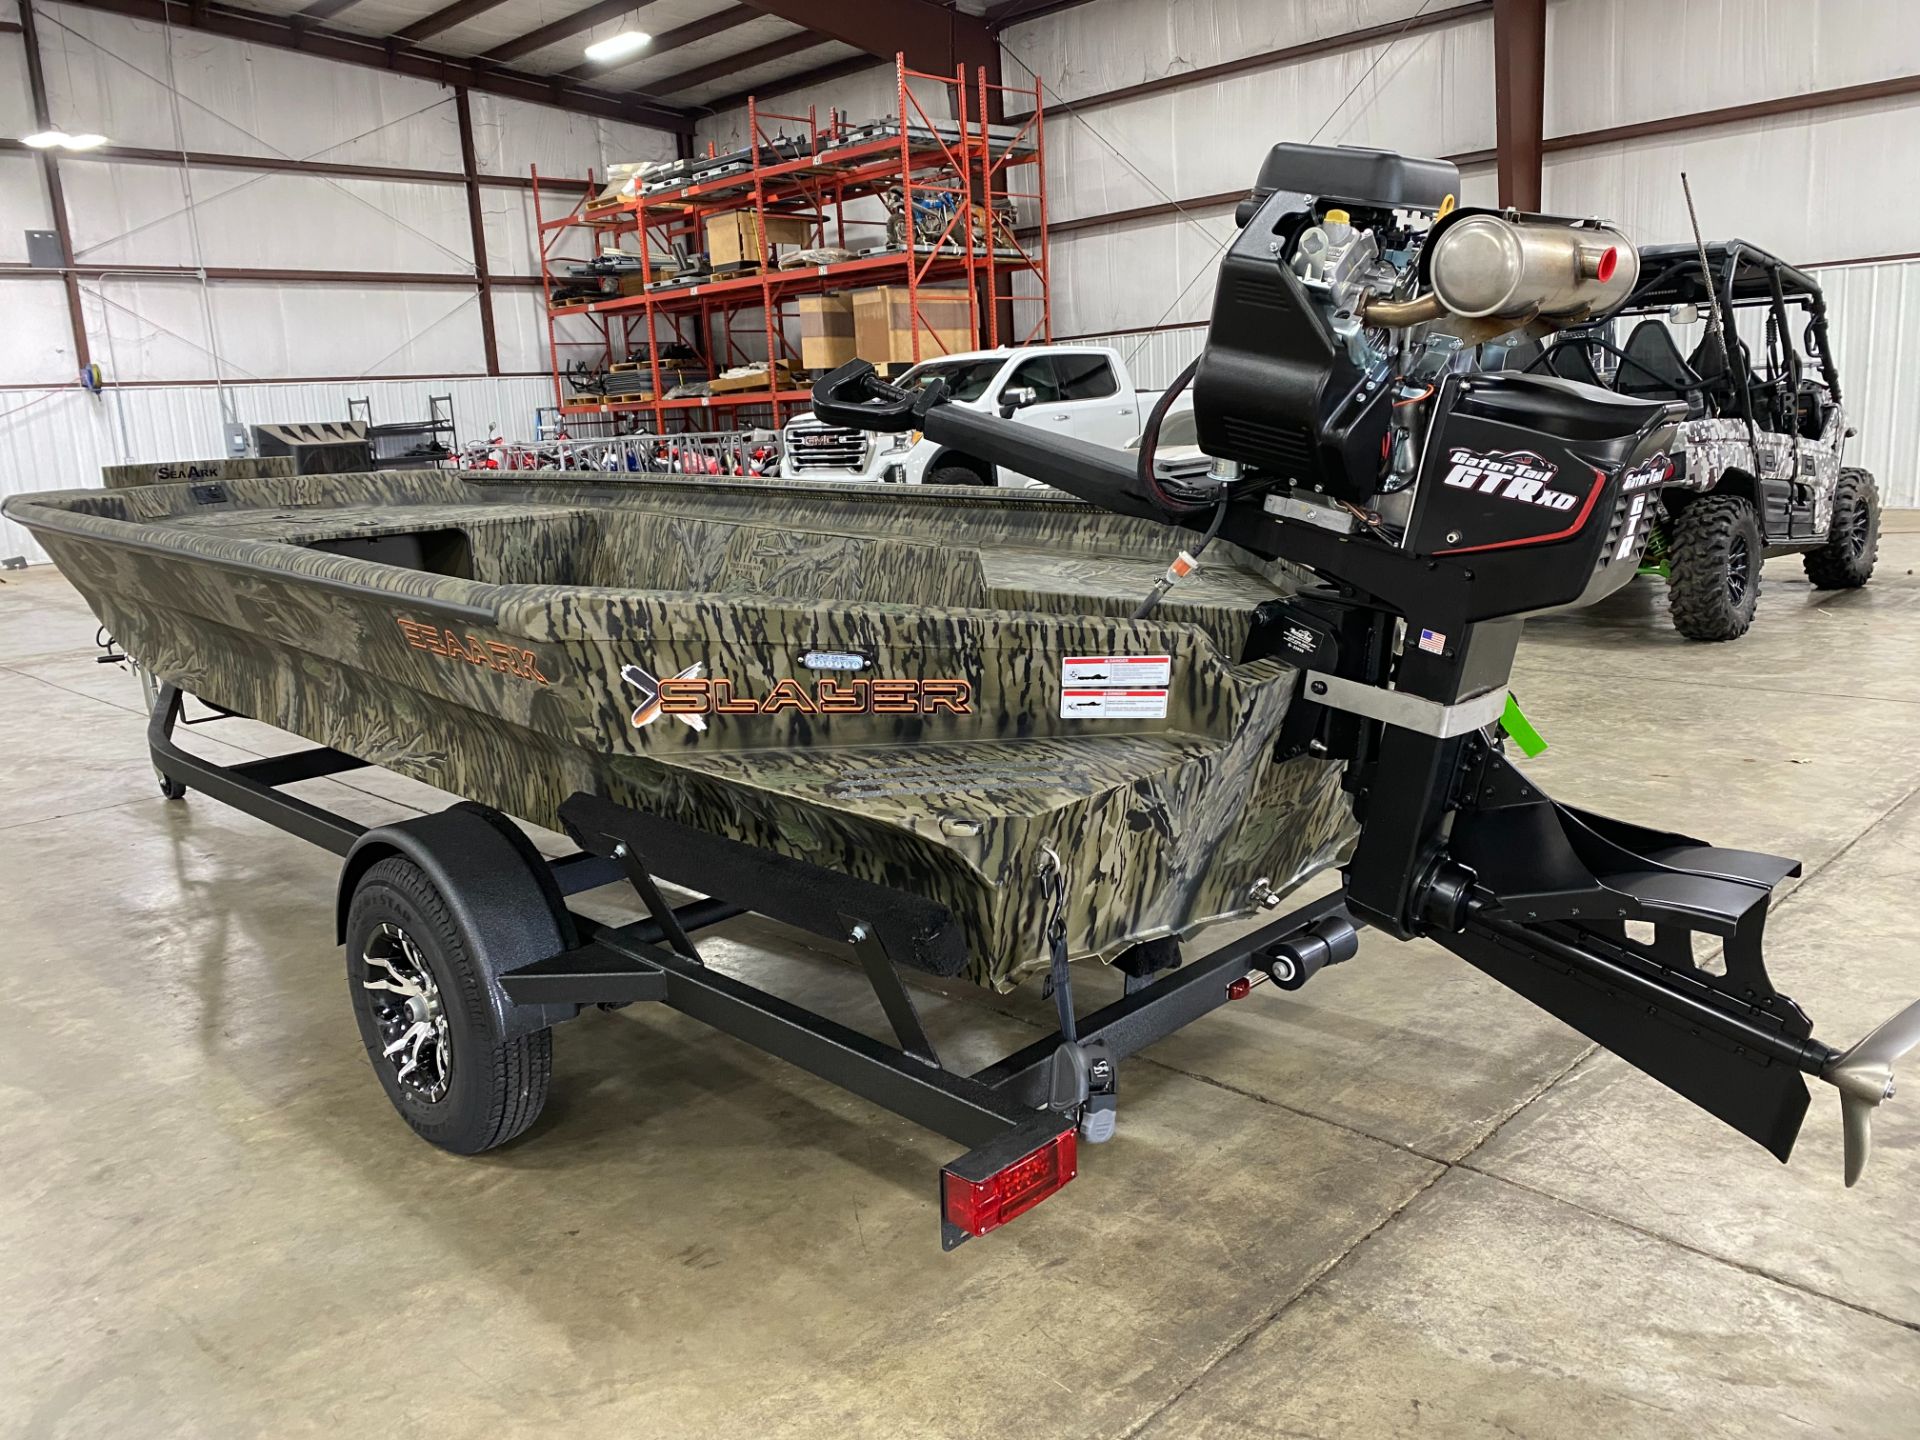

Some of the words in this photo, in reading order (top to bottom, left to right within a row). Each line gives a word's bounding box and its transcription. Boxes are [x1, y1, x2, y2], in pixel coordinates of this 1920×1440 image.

[804, 435, 838, 446] GMC
[1450, 452, 1554, 482] GatorTail
[397, 618, 549, 686] SEAARK
[659, 679, 972, 715] SLAYER
